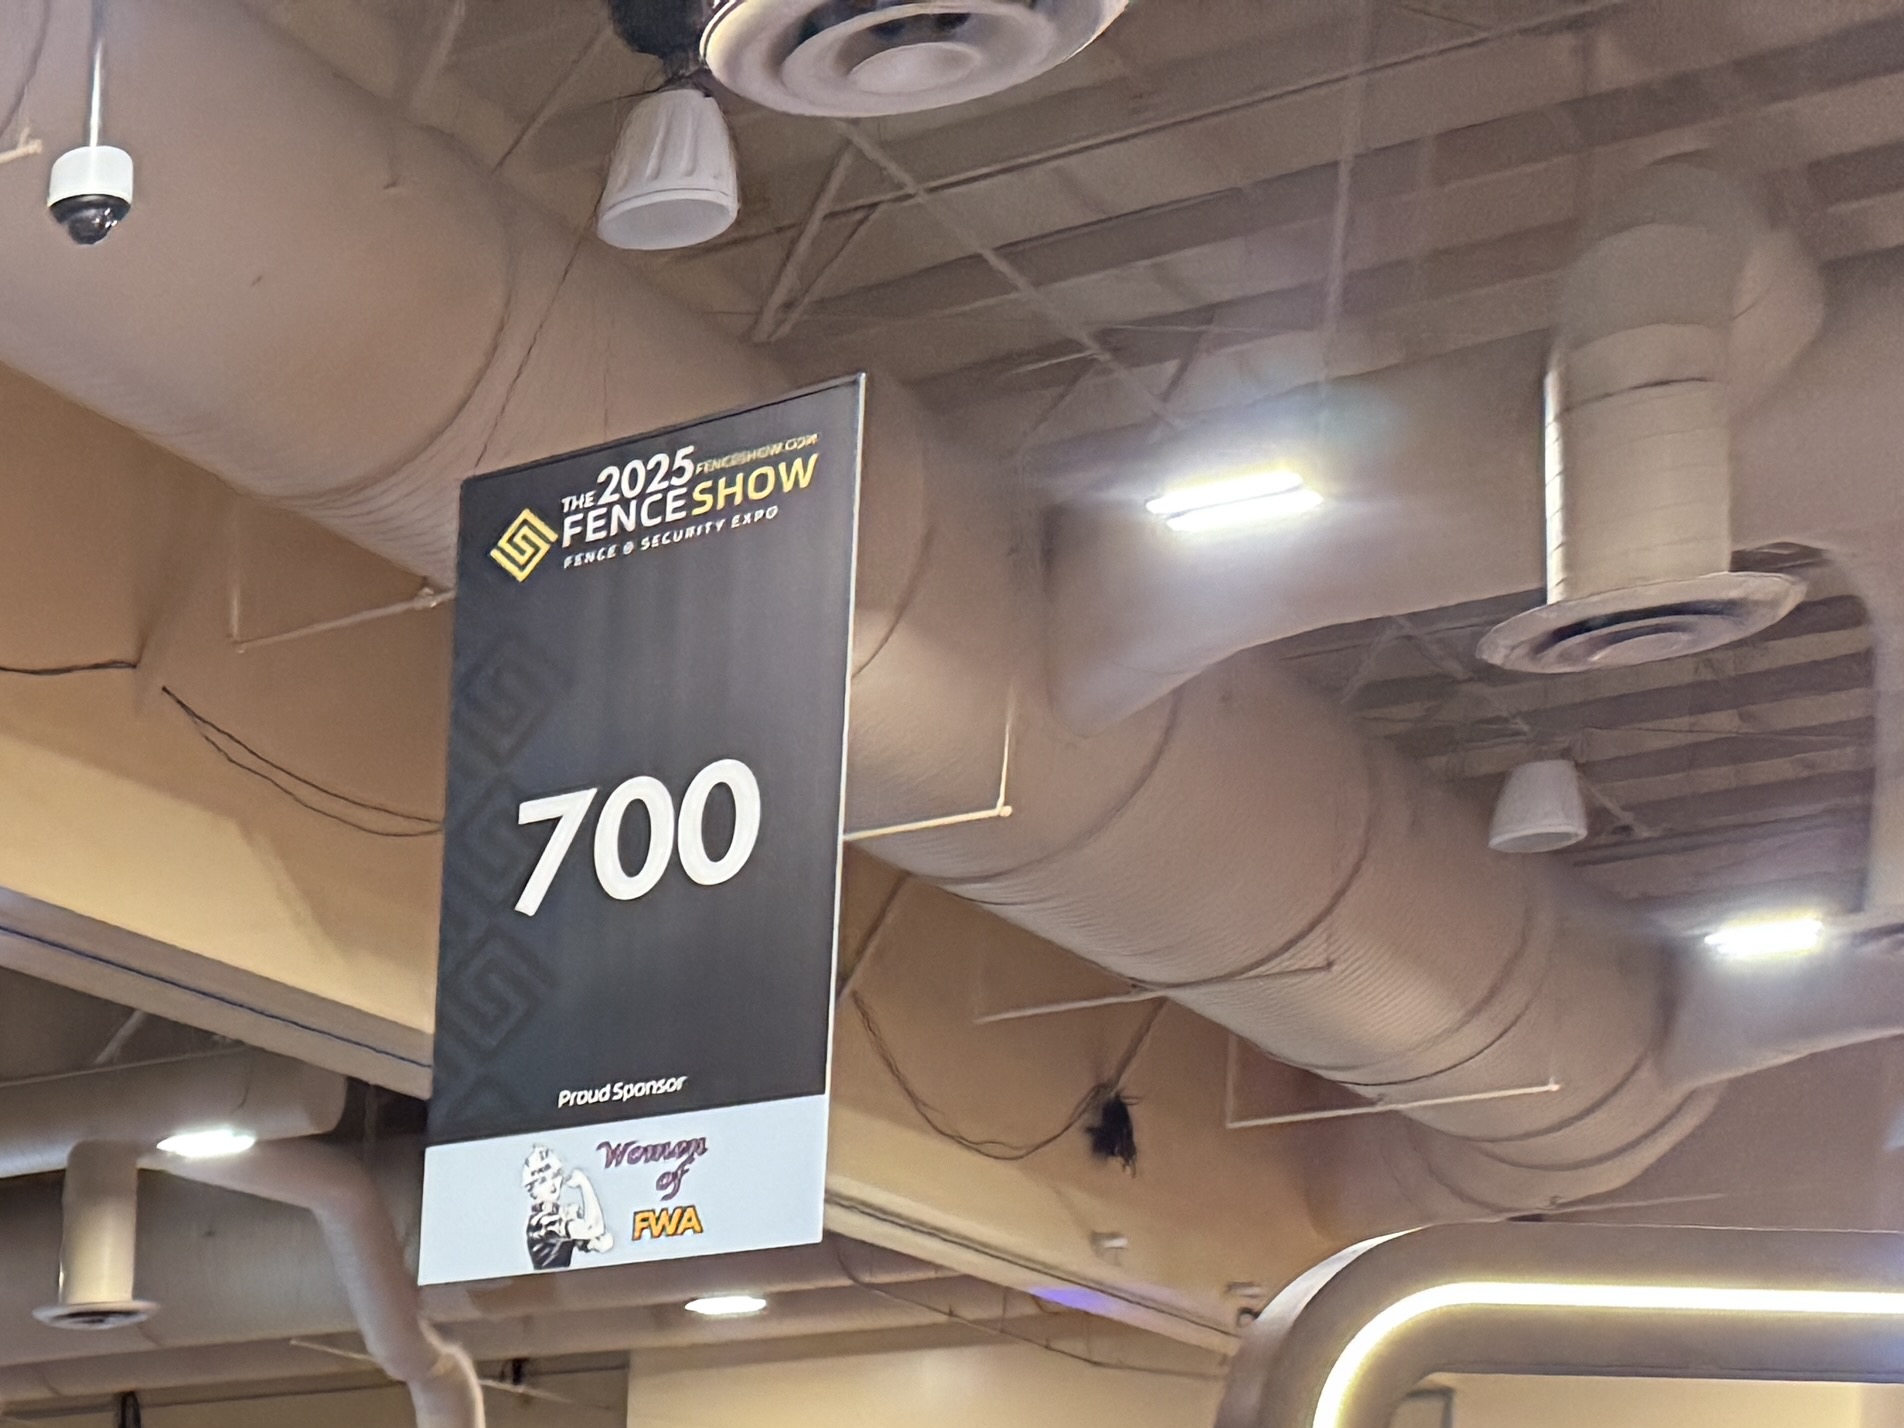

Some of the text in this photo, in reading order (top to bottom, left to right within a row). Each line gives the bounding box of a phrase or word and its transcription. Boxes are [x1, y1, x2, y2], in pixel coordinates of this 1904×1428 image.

[561, 445, 695, 513] THE 2025
[563, 544, 619, 569] FENCE
[640, 518, 727, 551] SECURITY
[731, 505, 779, 530] EXPO
[514, 759, 761, 917] 700
[558, 1074, 689, 1108] Proud Sponsor
[656, 1152, 695, 1201] of
[632, 1204, 704, 1241] FWA
